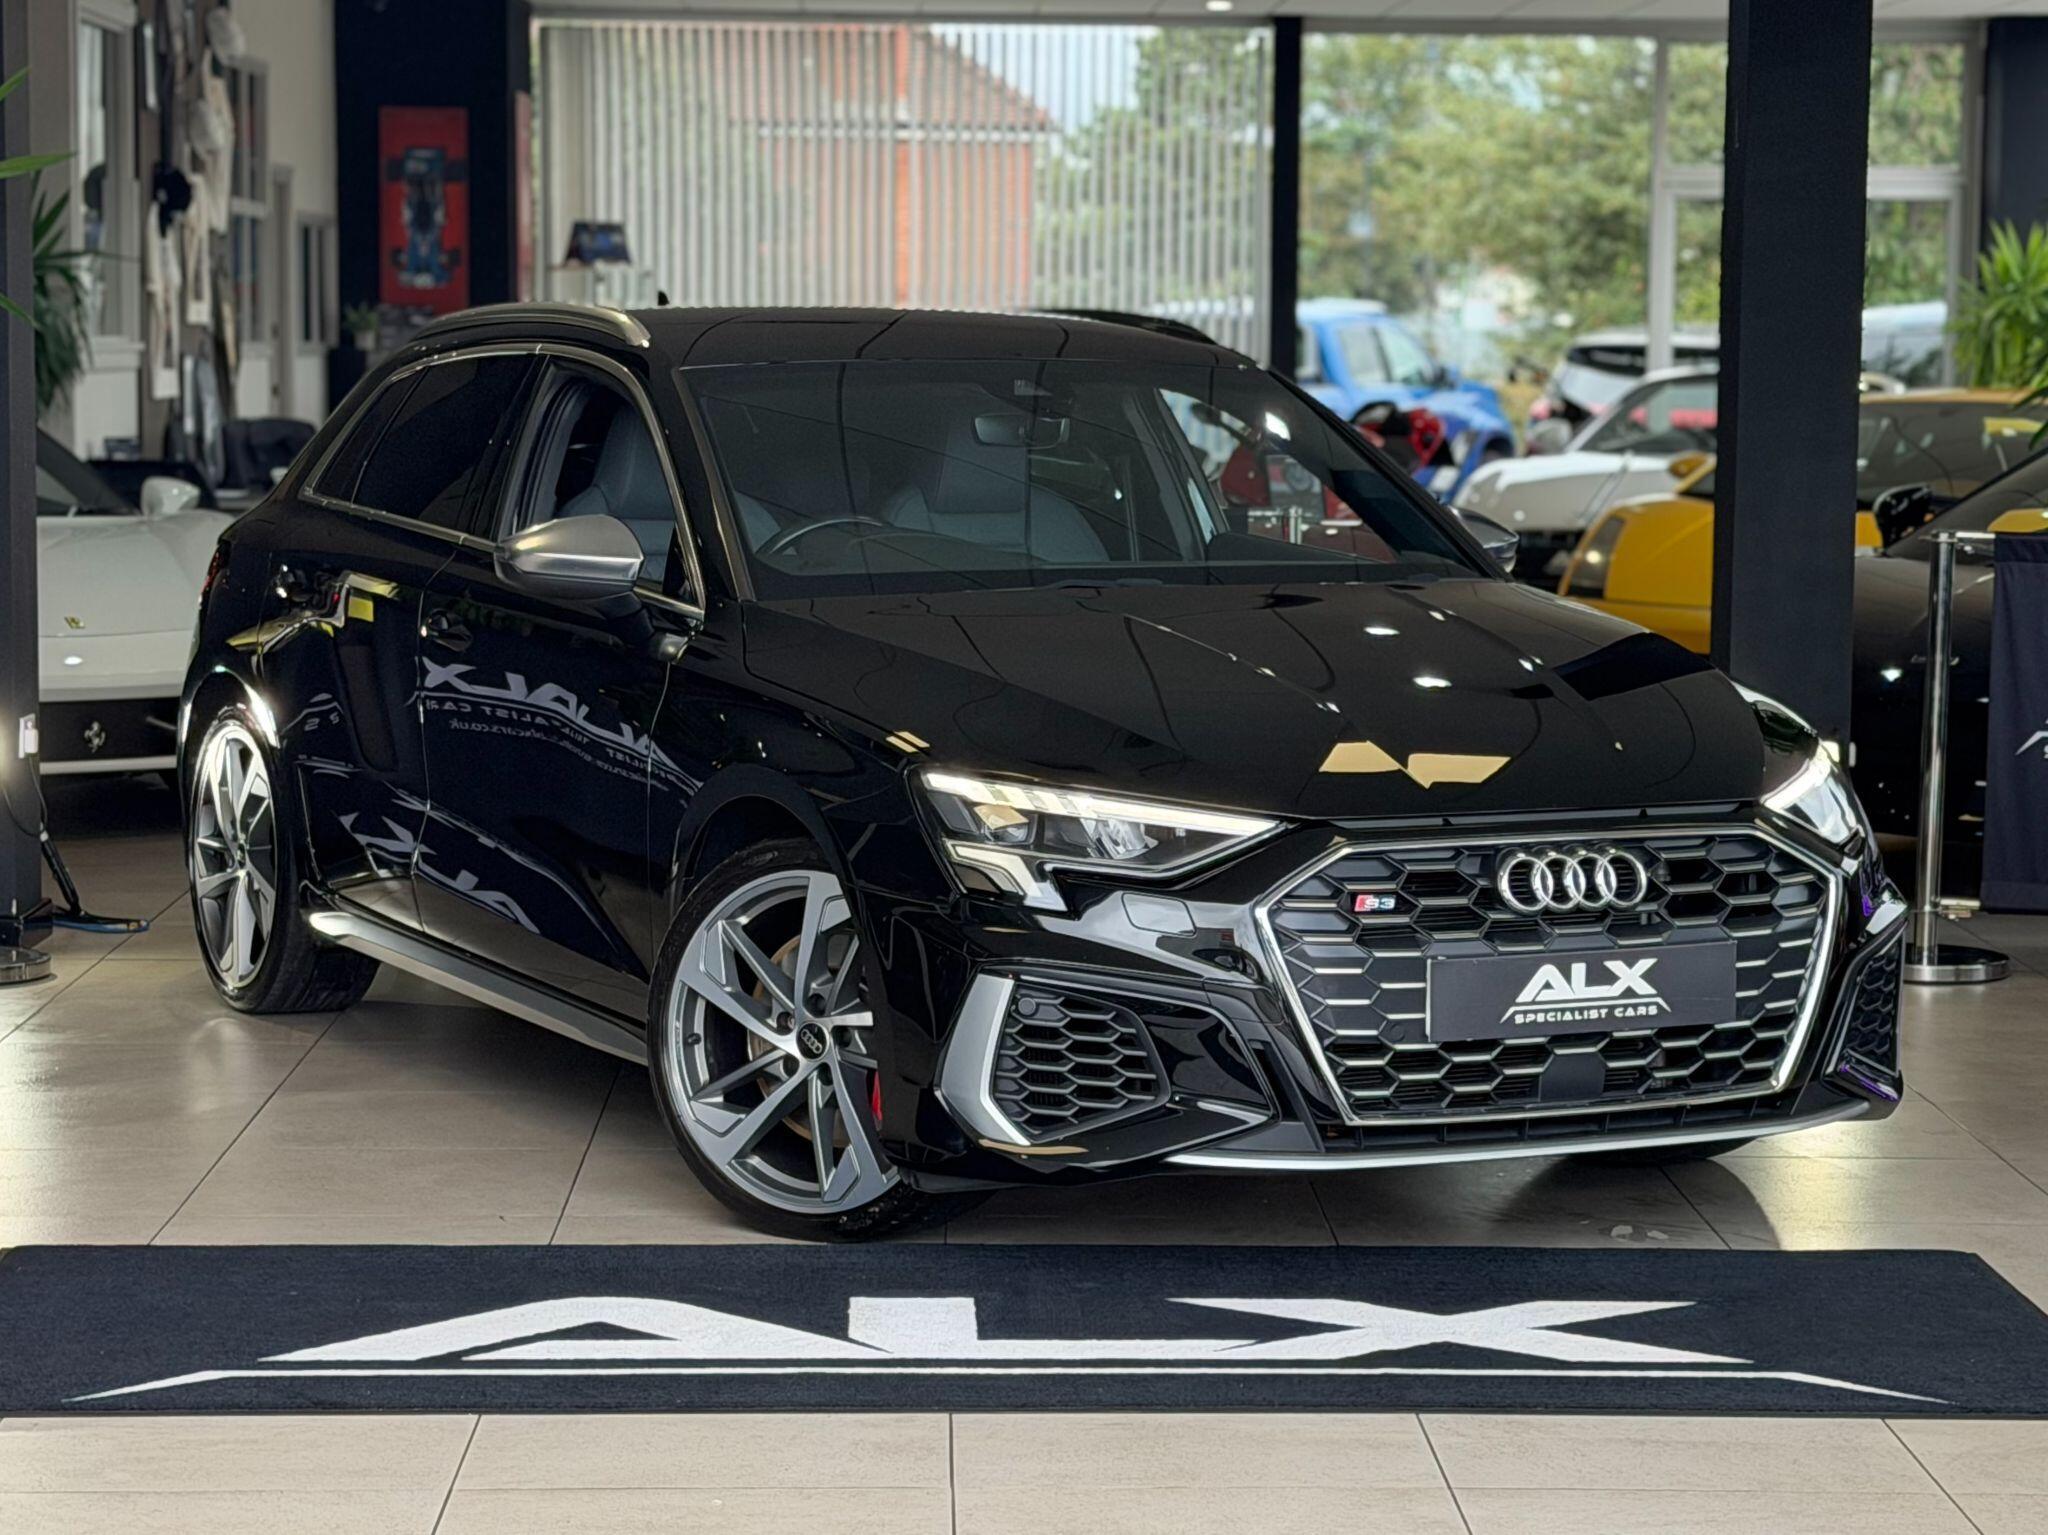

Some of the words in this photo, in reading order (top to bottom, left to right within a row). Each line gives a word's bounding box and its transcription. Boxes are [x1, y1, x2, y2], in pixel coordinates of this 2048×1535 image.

[1361, 895, 1396, 911] S3
[1515, 957, 1658, 1003] ALX
[1514, 1007, 1609, 1024] SPECIALIST
[1614, 1005, 1658, 1018] CARS
[257, 1296, 1755, 1364] ALX
